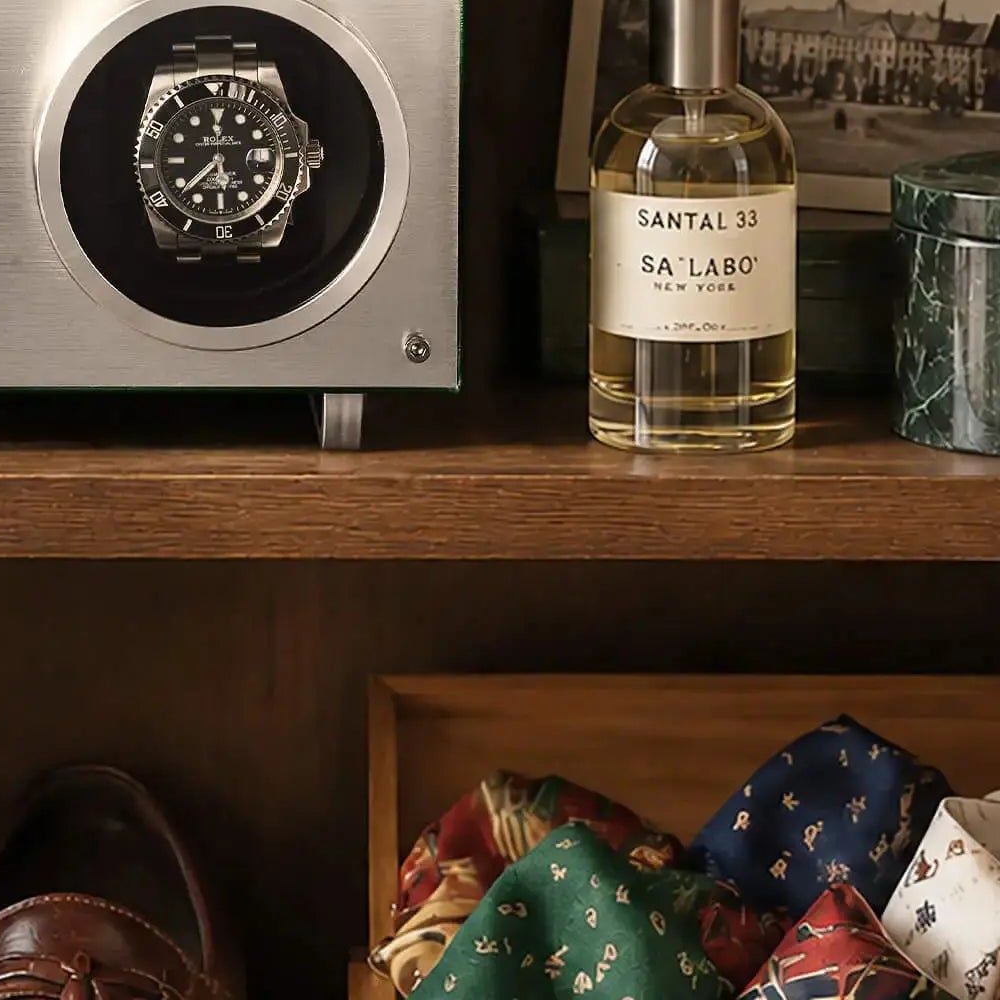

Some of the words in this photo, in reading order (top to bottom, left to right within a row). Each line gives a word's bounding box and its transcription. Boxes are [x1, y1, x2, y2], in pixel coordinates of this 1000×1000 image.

[147, 121, 164, 139] 50
[150, 190, 169, 208] 40
[275, 182, 293, 201] 20
[638, 208, 727, 231] SANTAL
[736, 210, 758, 229] 33
[215, 225, 233, 239] 30
[653, 282, 687, 291] NEW
